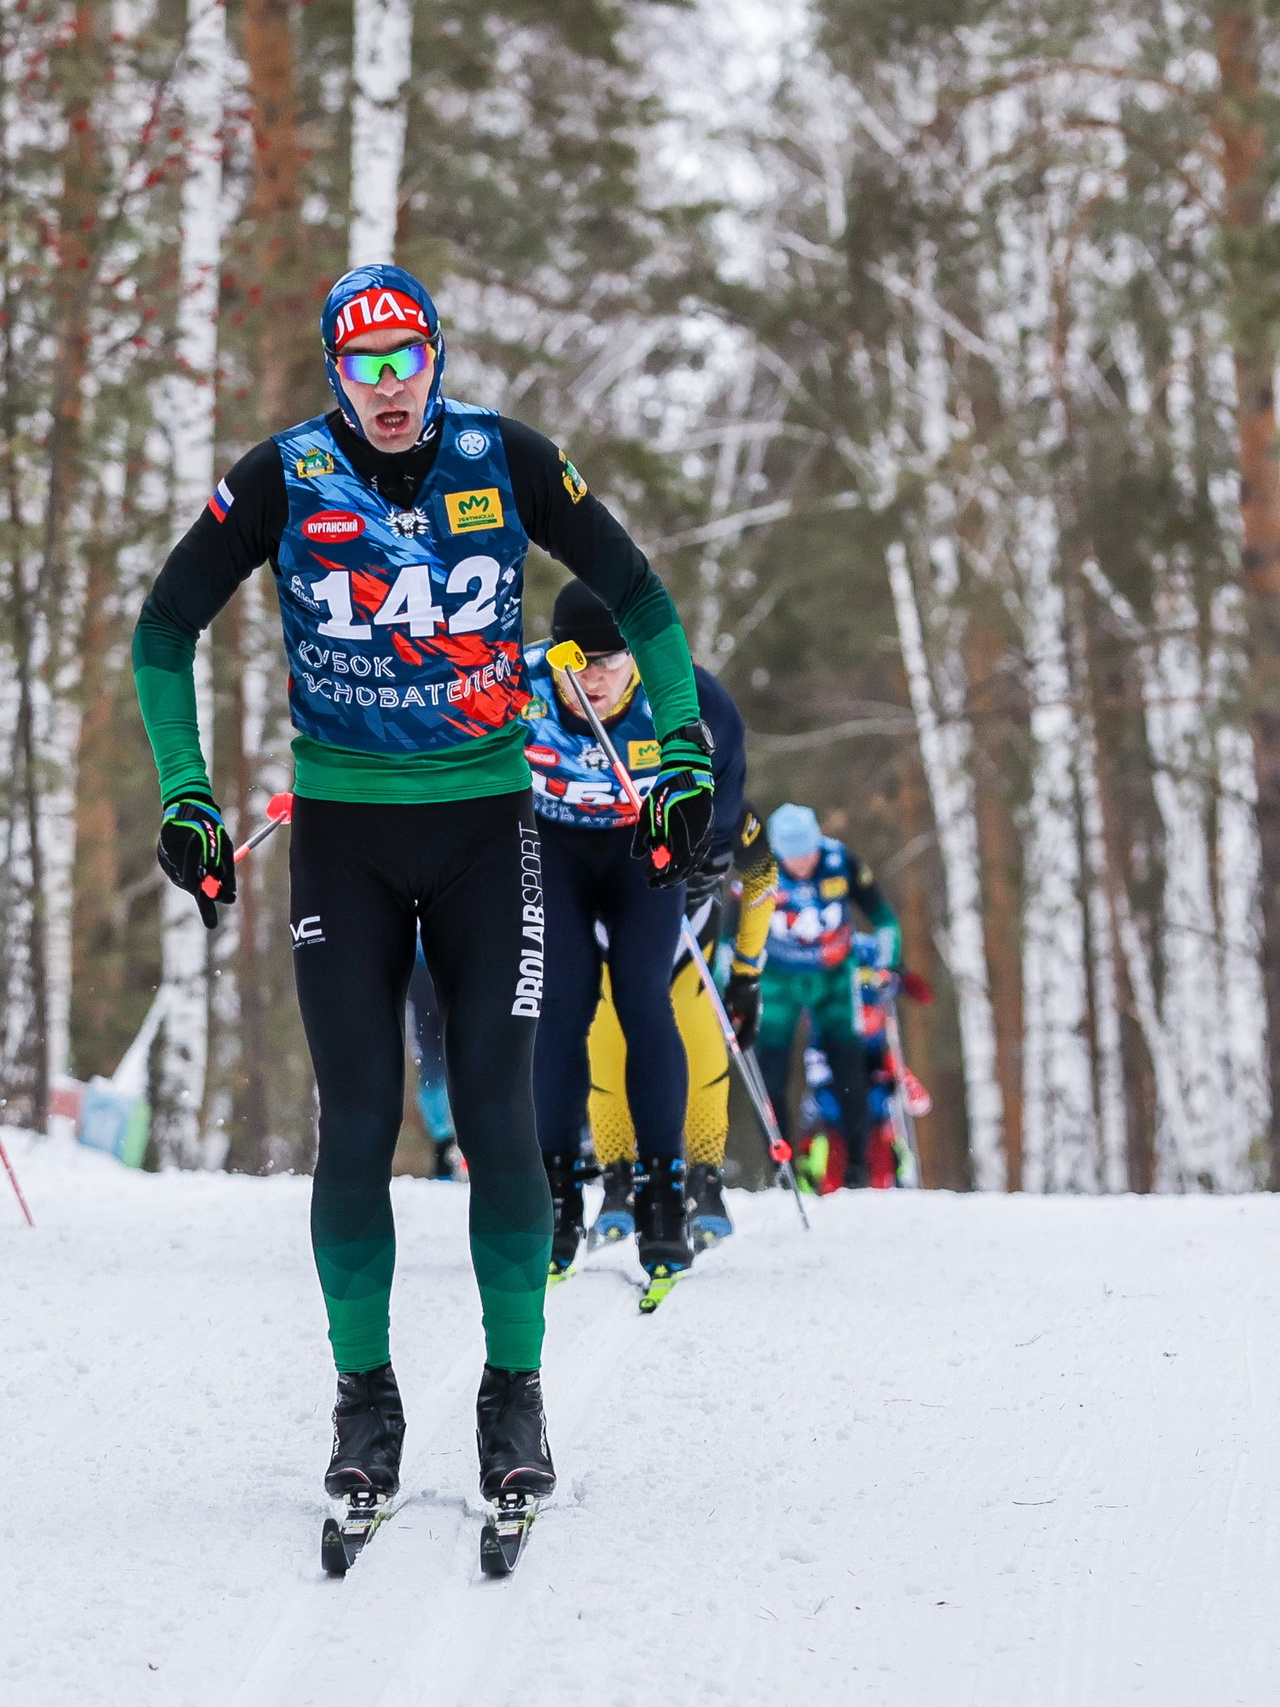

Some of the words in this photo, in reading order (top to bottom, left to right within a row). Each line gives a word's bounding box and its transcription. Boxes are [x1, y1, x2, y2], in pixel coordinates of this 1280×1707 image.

[307, 518, 358, 534] КУРГАНСКИЙ
[310, 555, 500, 640] 142
[298, 640, 396, 678] КУБОК
